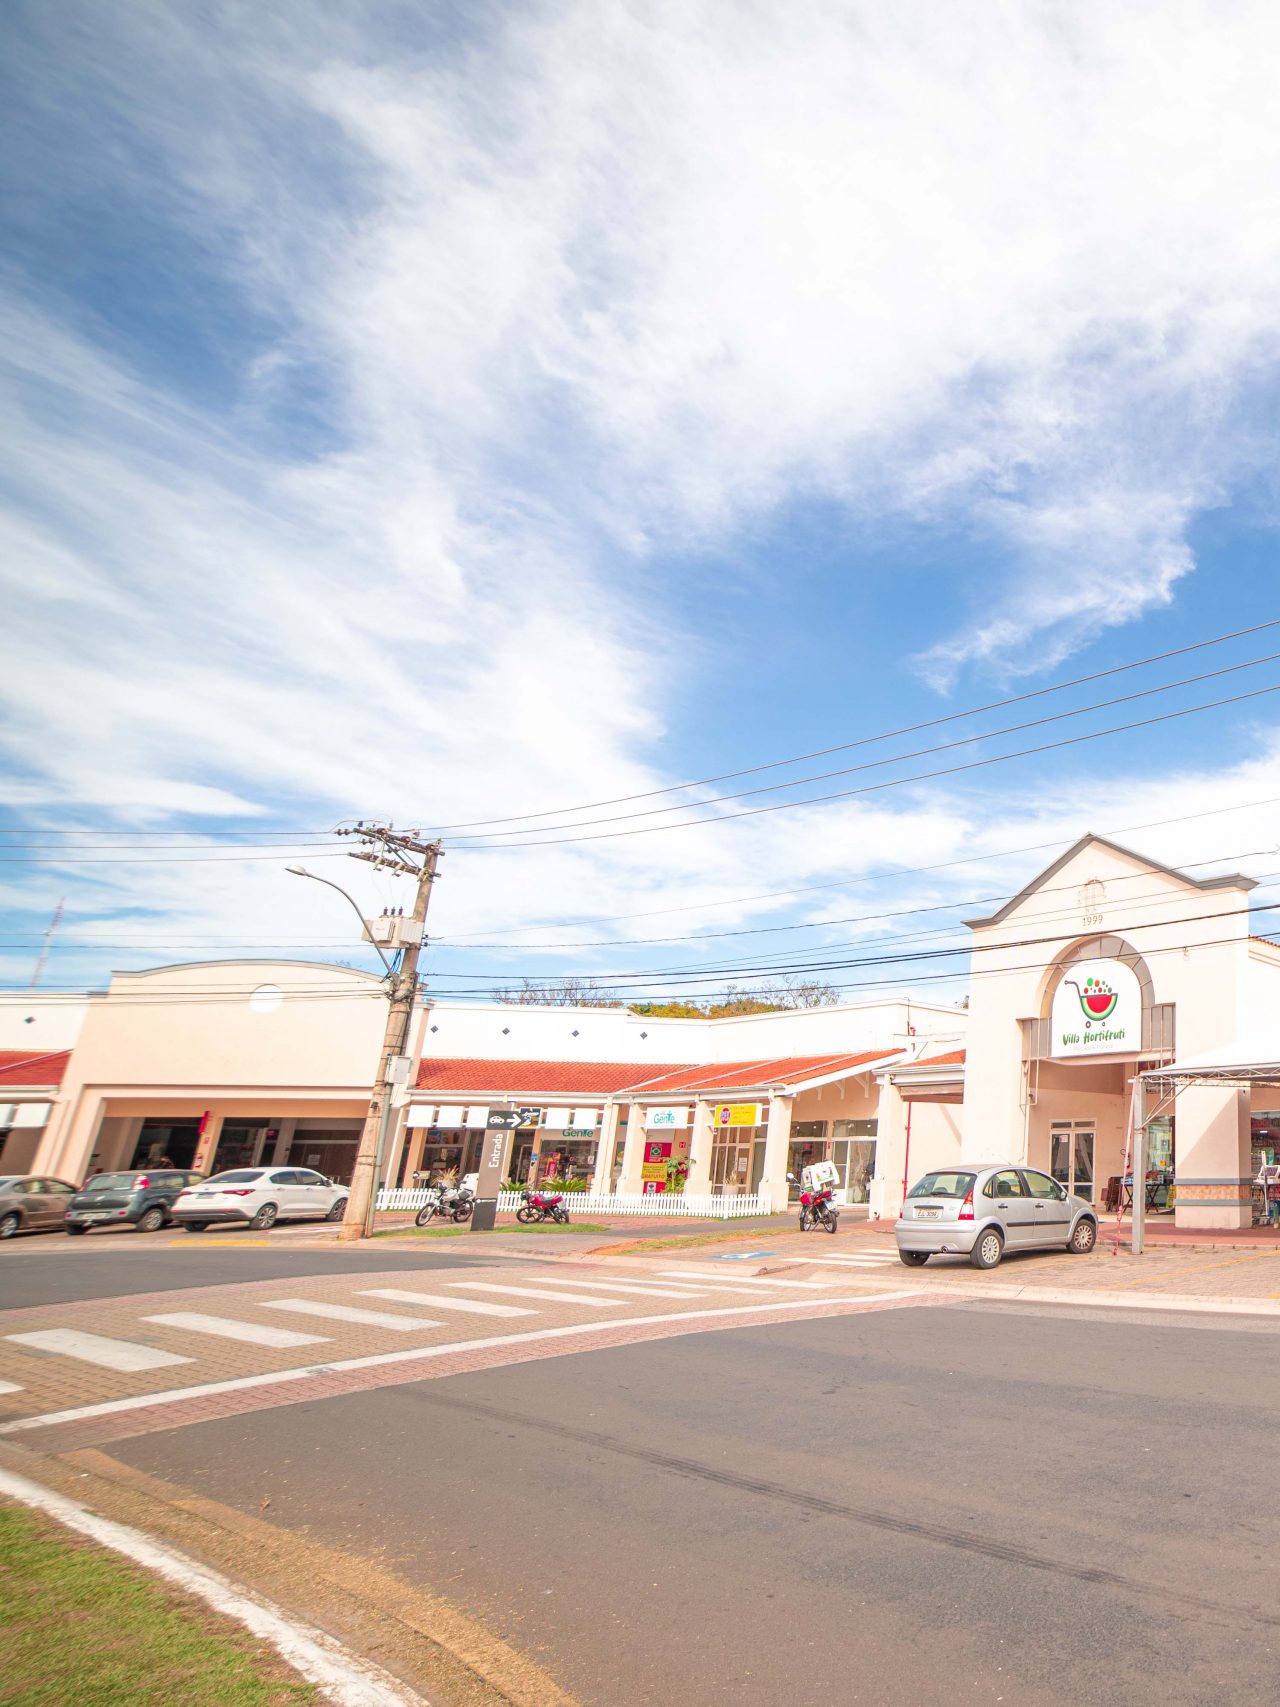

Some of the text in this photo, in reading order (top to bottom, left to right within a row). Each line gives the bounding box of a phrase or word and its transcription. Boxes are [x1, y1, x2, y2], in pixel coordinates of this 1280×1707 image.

[1082, 914, 1104, 927] 1999
[1062, 1028, 1126, 1046] Villa Hortifruti
[488, 1133, 503, 1169] Entrada
